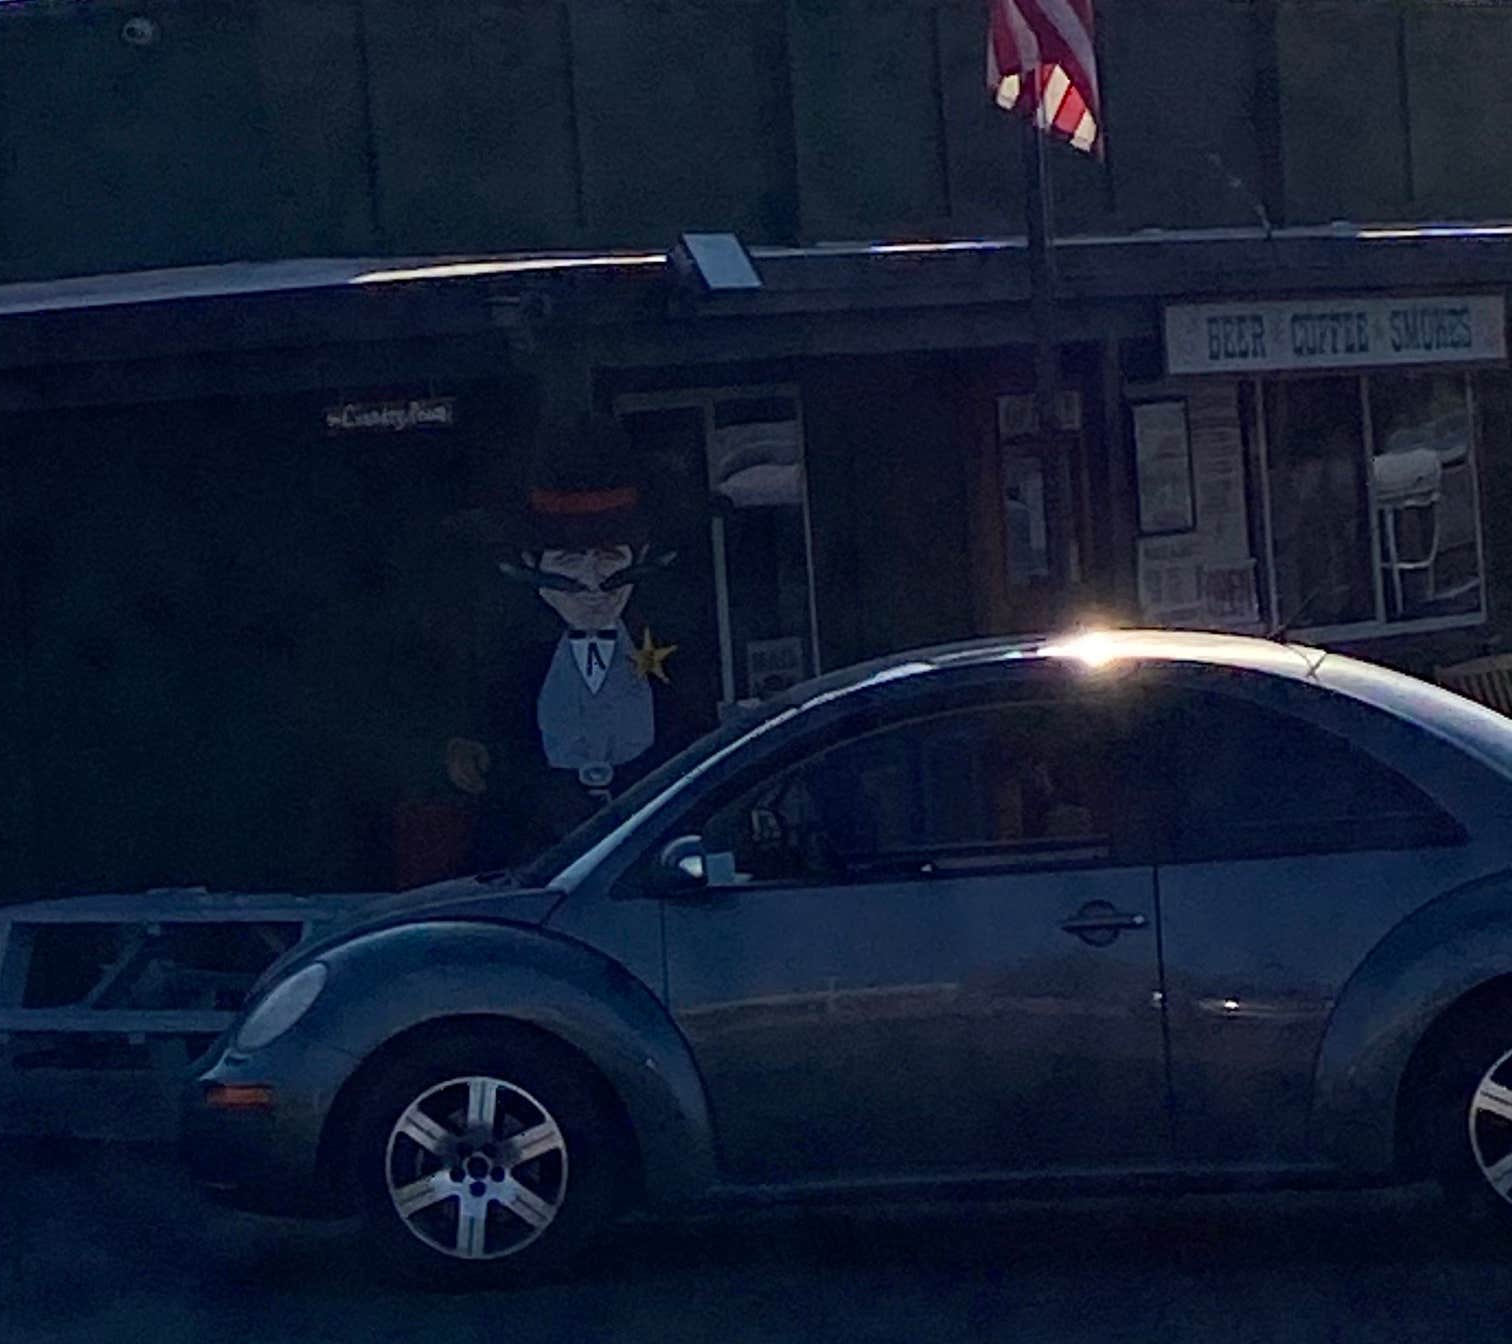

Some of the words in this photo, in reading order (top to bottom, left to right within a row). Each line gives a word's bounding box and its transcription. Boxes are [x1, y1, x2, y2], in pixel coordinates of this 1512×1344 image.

[1207, 313, 1267, 360] BEER
[1291, 311, 1369, 356] COFFEE
[1390, 307, 1472, 350] SMOKES
